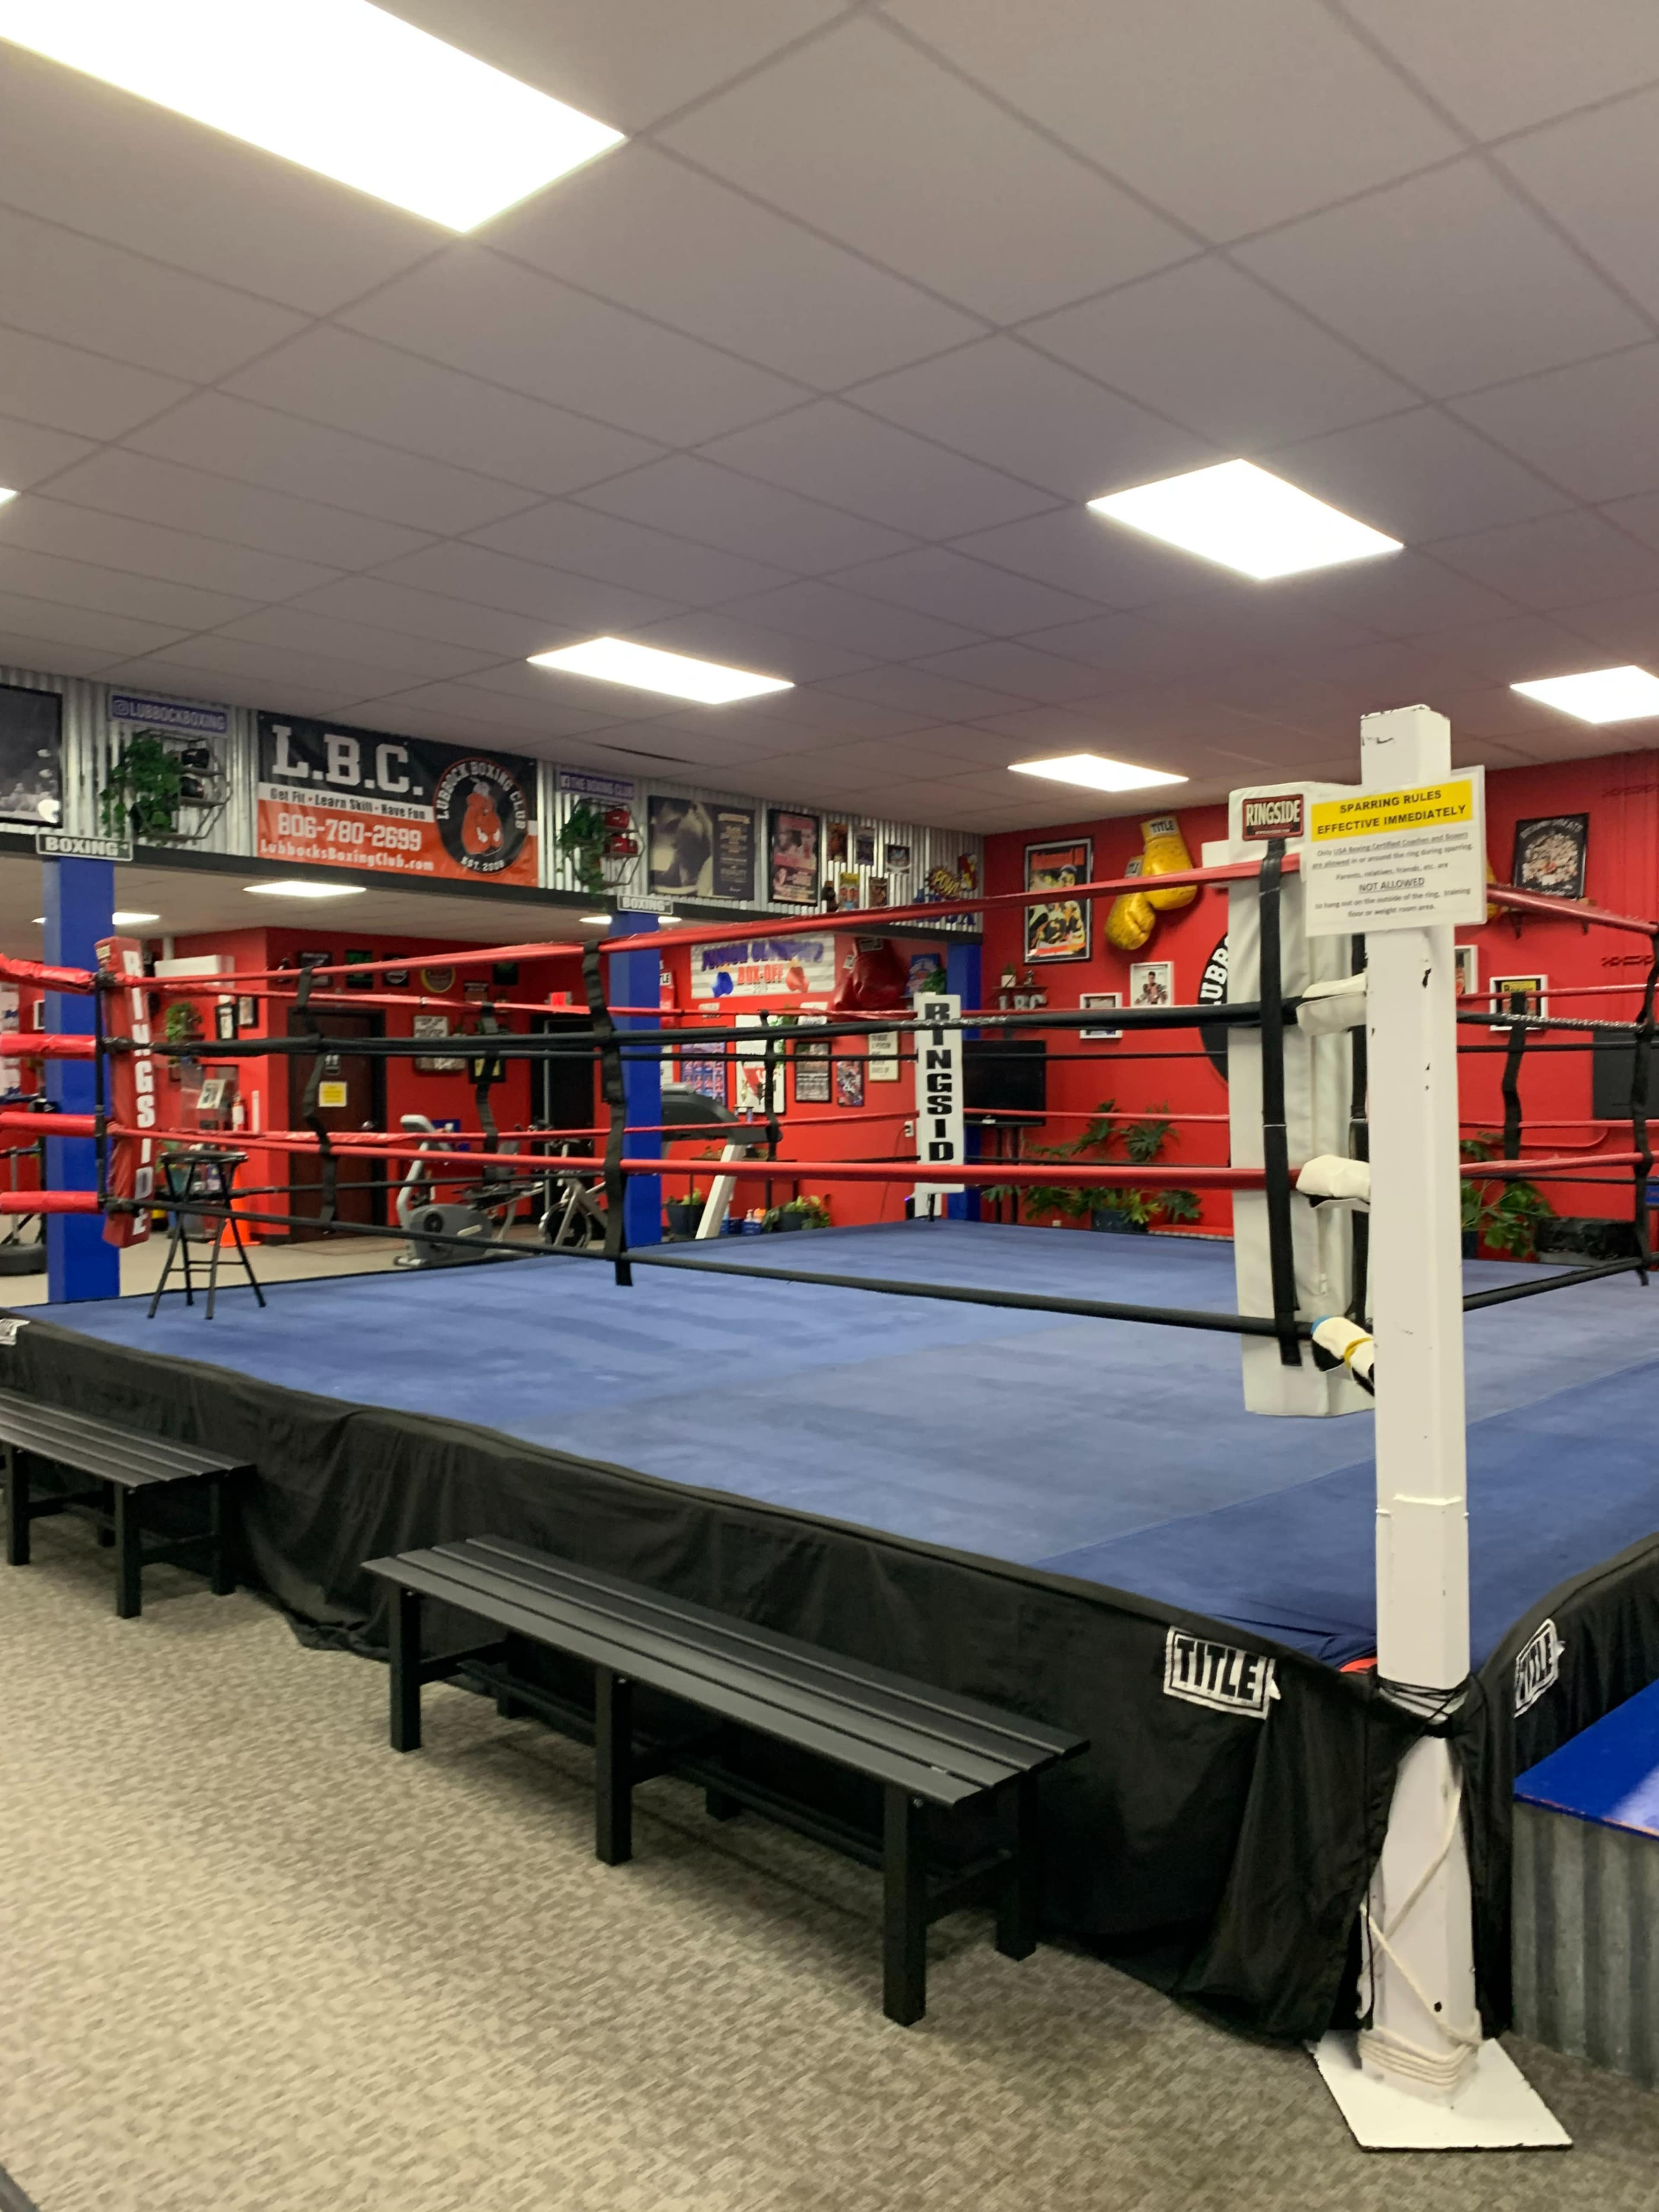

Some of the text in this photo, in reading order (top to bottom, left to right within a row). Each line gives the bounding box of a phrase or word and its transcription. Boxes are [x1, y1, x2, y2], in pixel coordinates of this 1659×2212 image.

[272, 725, 423, 796] L.B.C.
[270, 788, 288, 801] Get
[315, 794, 346, 809] Learn
[350, 799, 373, 812] Skill
[381, 804, 404, 817] Have
[408, 807, 425, 820] Fun
[436, 762, 526, 829] LUBBOCK BOXING CLUB
[1340, 790, 1441, 814] SPARRING RULES
[1151, 820, 1174, 833] TITLE
[1246, 800, 1300, 826] RINGSIDE
[1317, 804, 1466, 834] EFFECTIVE IMMEDIATELY
[45, 836, 118, 856] BOXING
[277, 813, 422, 852] 806-780-2699
[1372, 840, 1401, 849] Certified
[260, 839, 433, 871] LubbocksBoxingClub.com
[1359, 877, 1425, 892] NOT ALLOWED
[623, 896, 664, 911] BOXING
[737, 963, 784, 985] BOX-OFF
[925, 1003, 954, 1161] RINGSID
[1177, 1637, 1259, 1701] TITLE
[1519, 1631, 1552, 1700] TITLE
